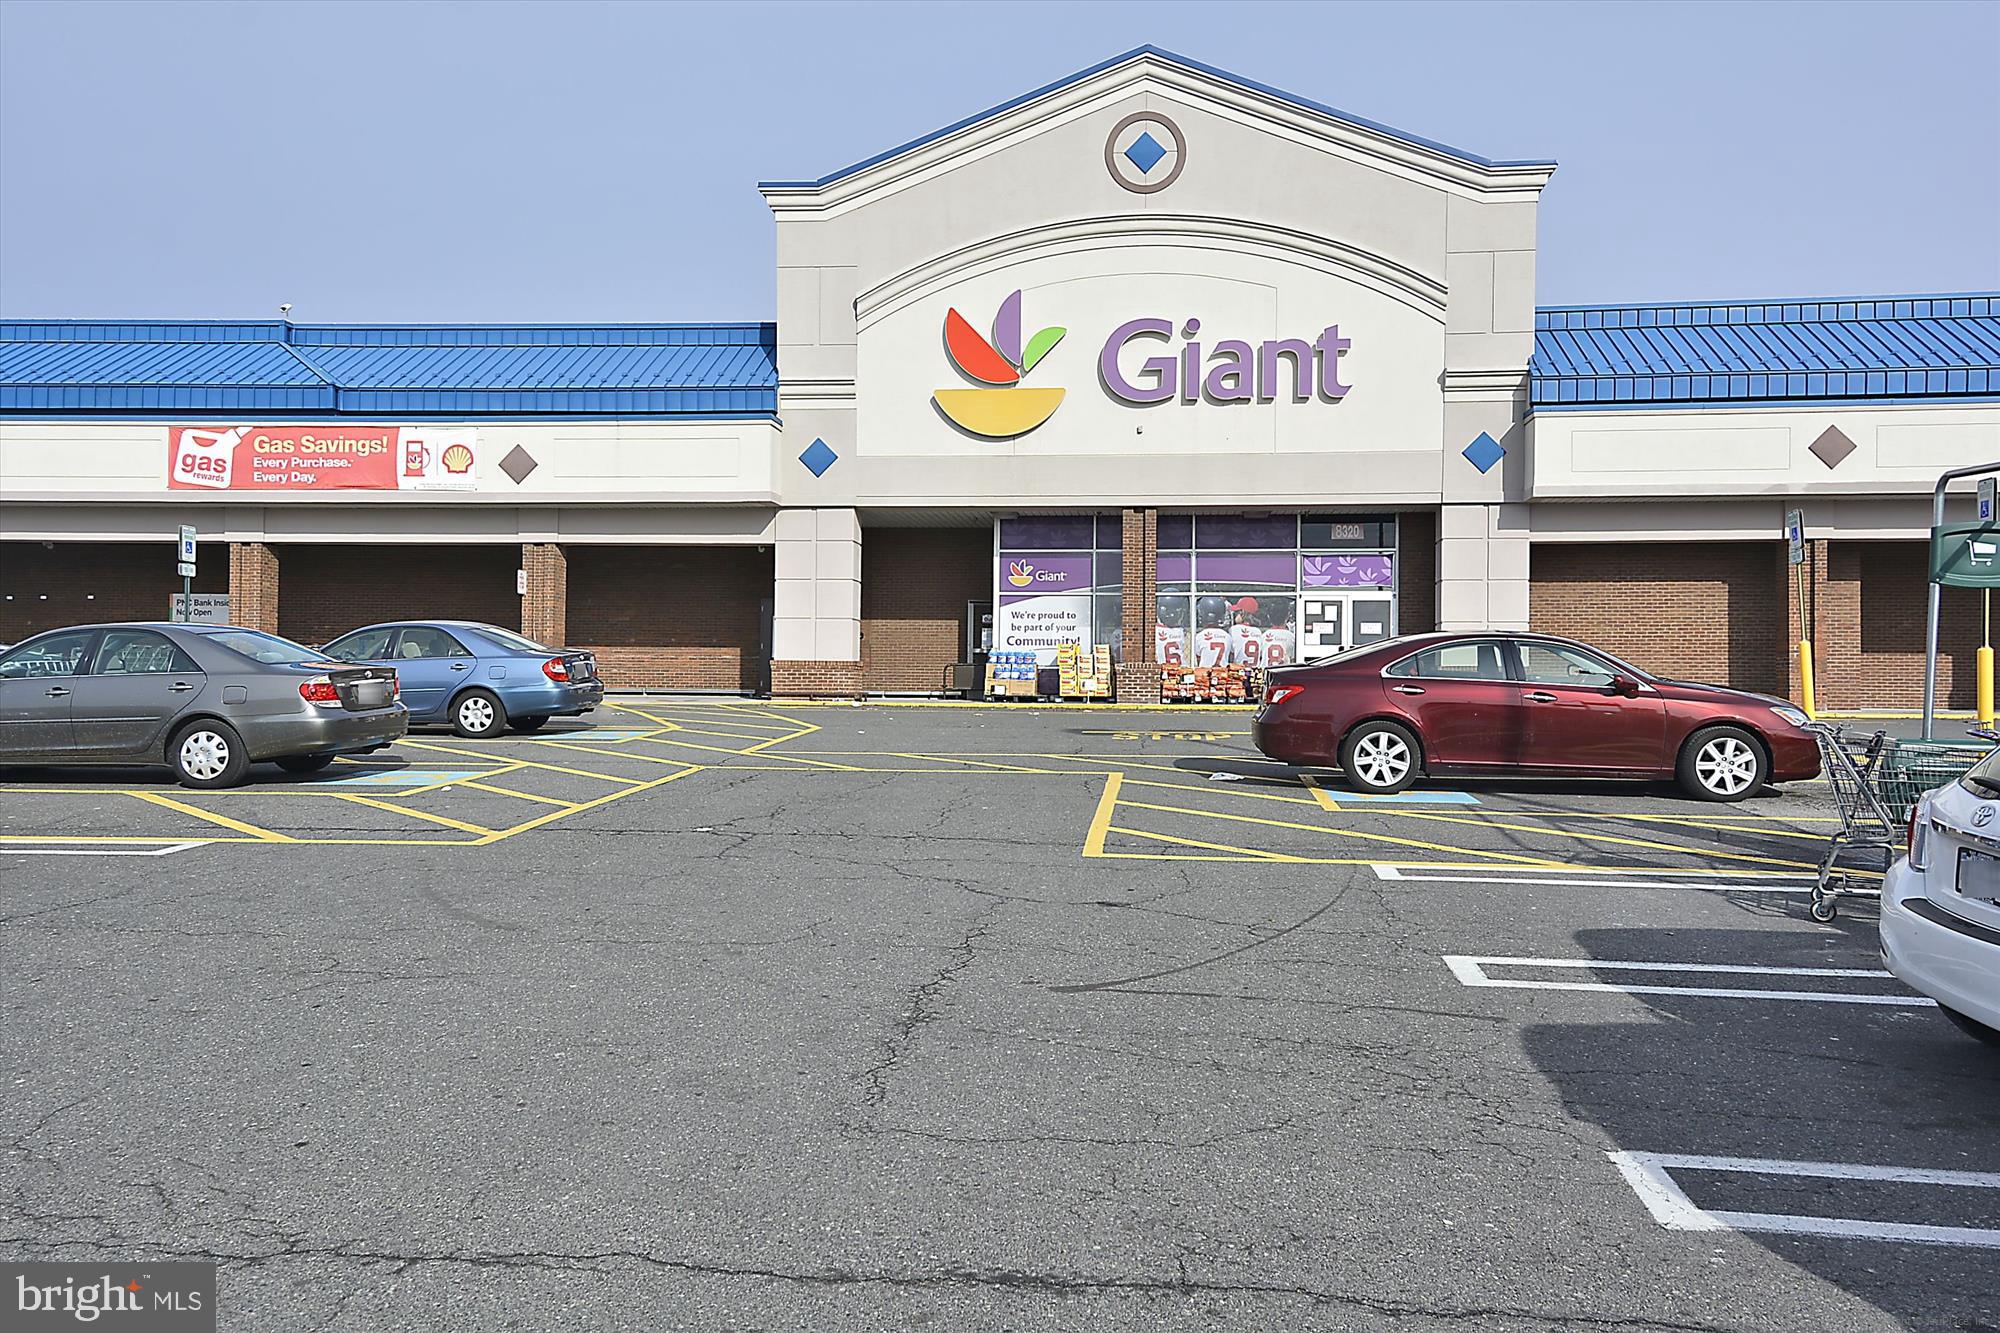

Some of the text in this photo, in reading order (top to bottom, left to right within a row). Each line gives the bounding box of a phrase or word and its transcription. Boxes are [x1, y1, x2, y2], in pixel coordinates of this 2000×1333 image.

[1100, 318, 1352, 406] Giant
[253, 435, 389, 457] Gas Savings!
[181, 453, 227, 474] gas
[253, 456, 352, 469] Every Purchase.
[193, 472, 225, 483] rewards
[253, 471, 317, 484] Every Day.
[1335, 525, 1360, 538] 8320
[1035, 570, 1065, 582] Giant
[193, 599, 212, 607] Bank
[193, 609, 213, 617] Open
[1011, 611, 1036, 619] We're
[1038, 611, 1065, 621] proud
[1011, 623, 1076, 633] be part of your
[1006, 636, 1081, 647] Community!
[1164, 642, 1182, 666] 6
[1210, 642, 1226, 667] 7
[1243, 641, 1260, 667] 9
[1267, 644, 1285, 666] 8
